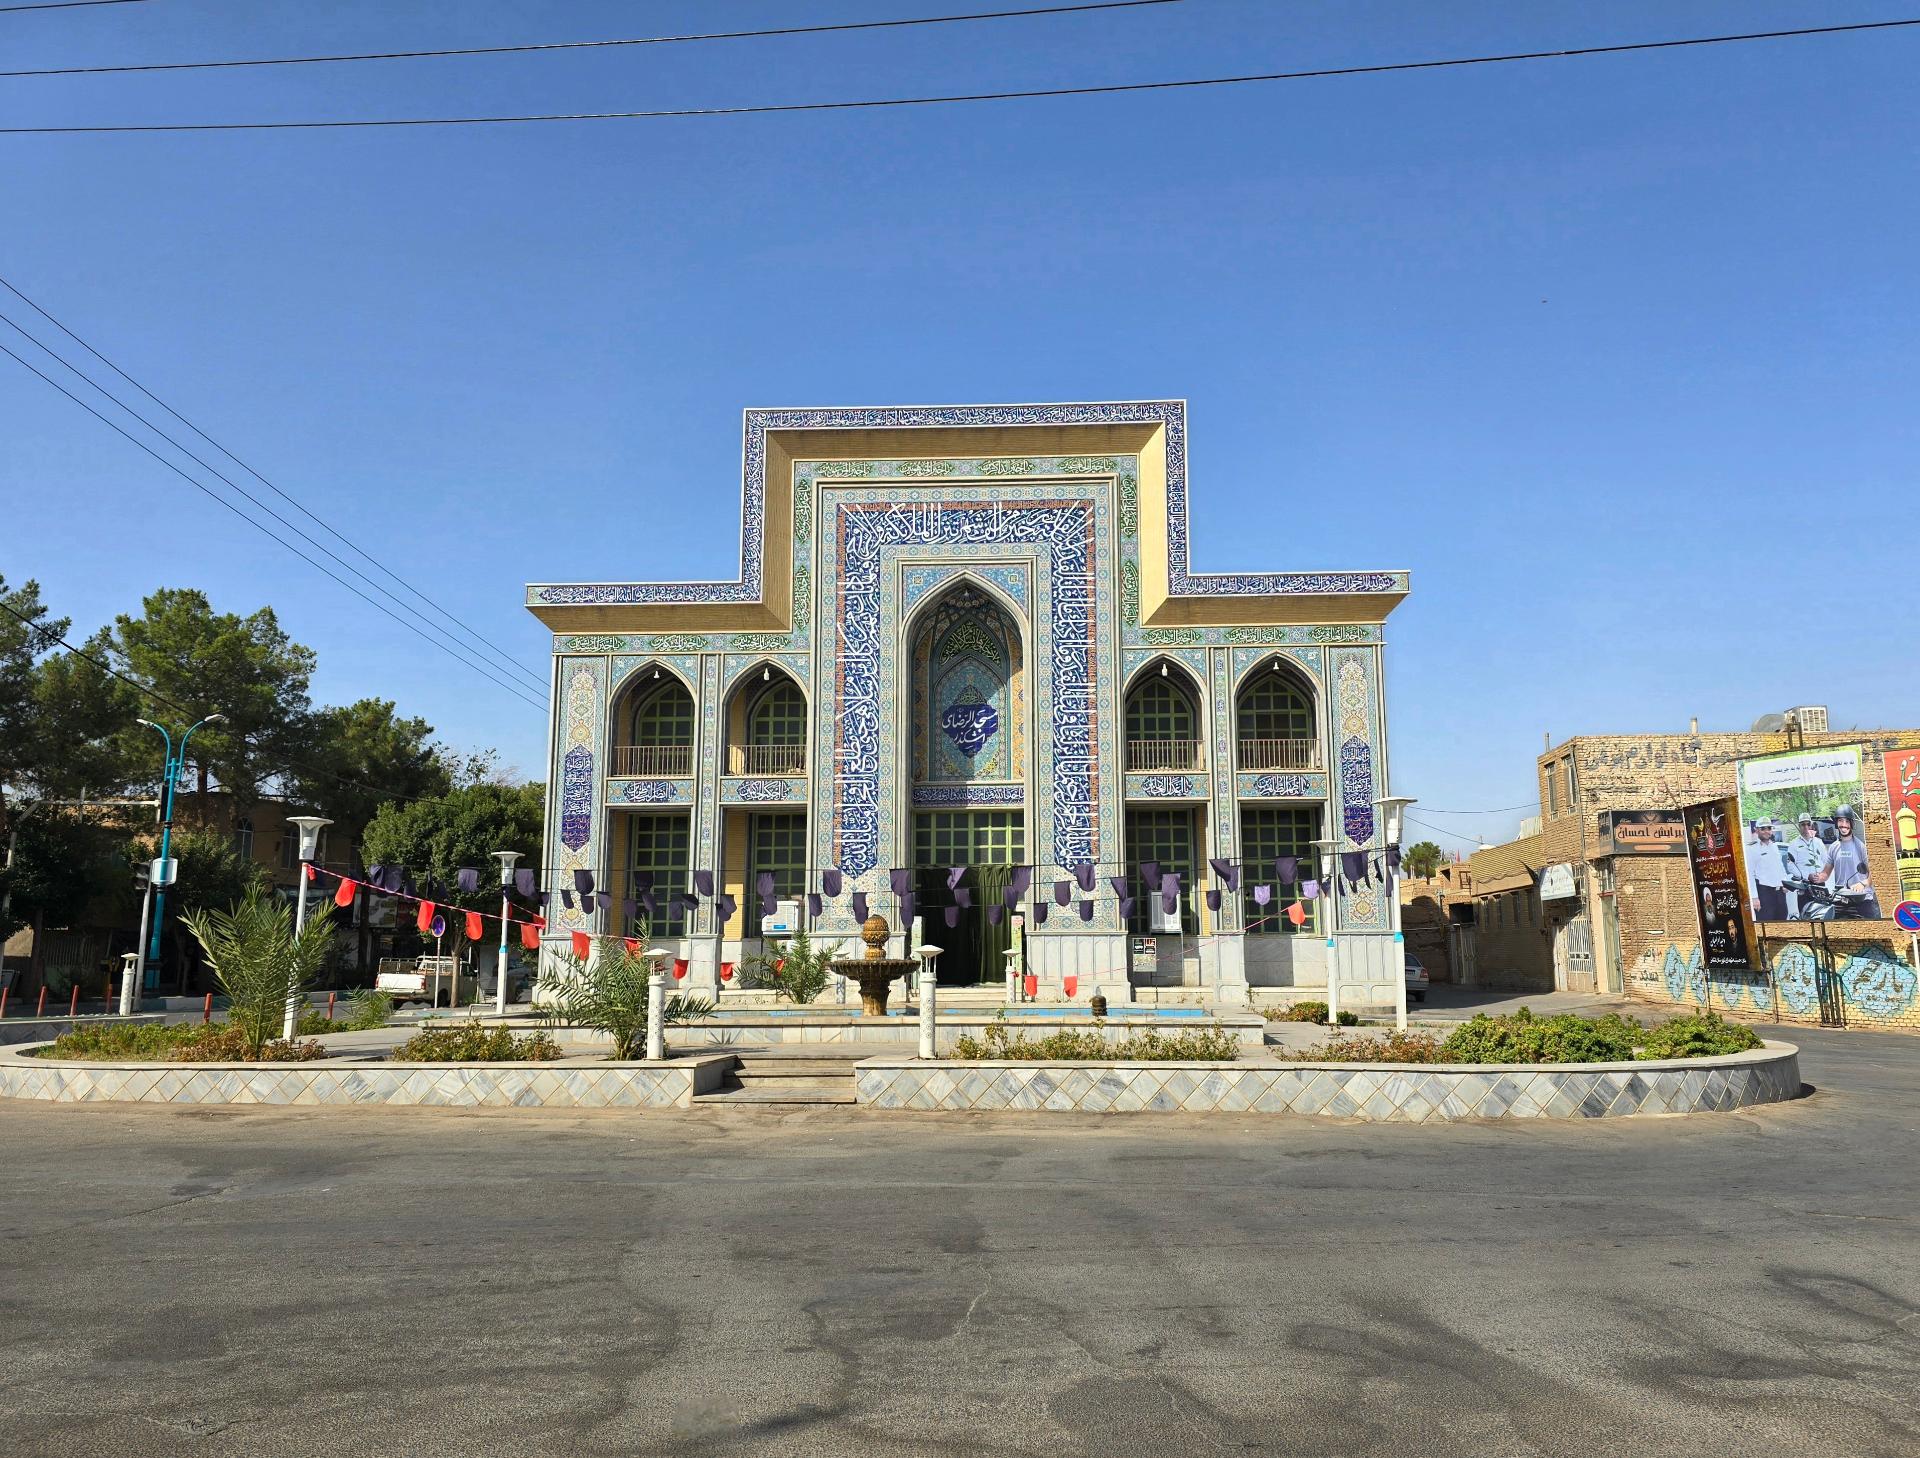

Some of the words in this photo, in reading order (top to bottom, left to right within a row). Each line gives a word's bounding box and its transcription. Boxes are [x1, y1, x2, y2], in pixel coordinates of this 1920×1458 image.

[942, 710, 975, 729] الرضای
[970, 708, 998, 732] مسجد
[954, 729, 986, 745] اشکذر
[1617, 826, 1650, 839] احسان
